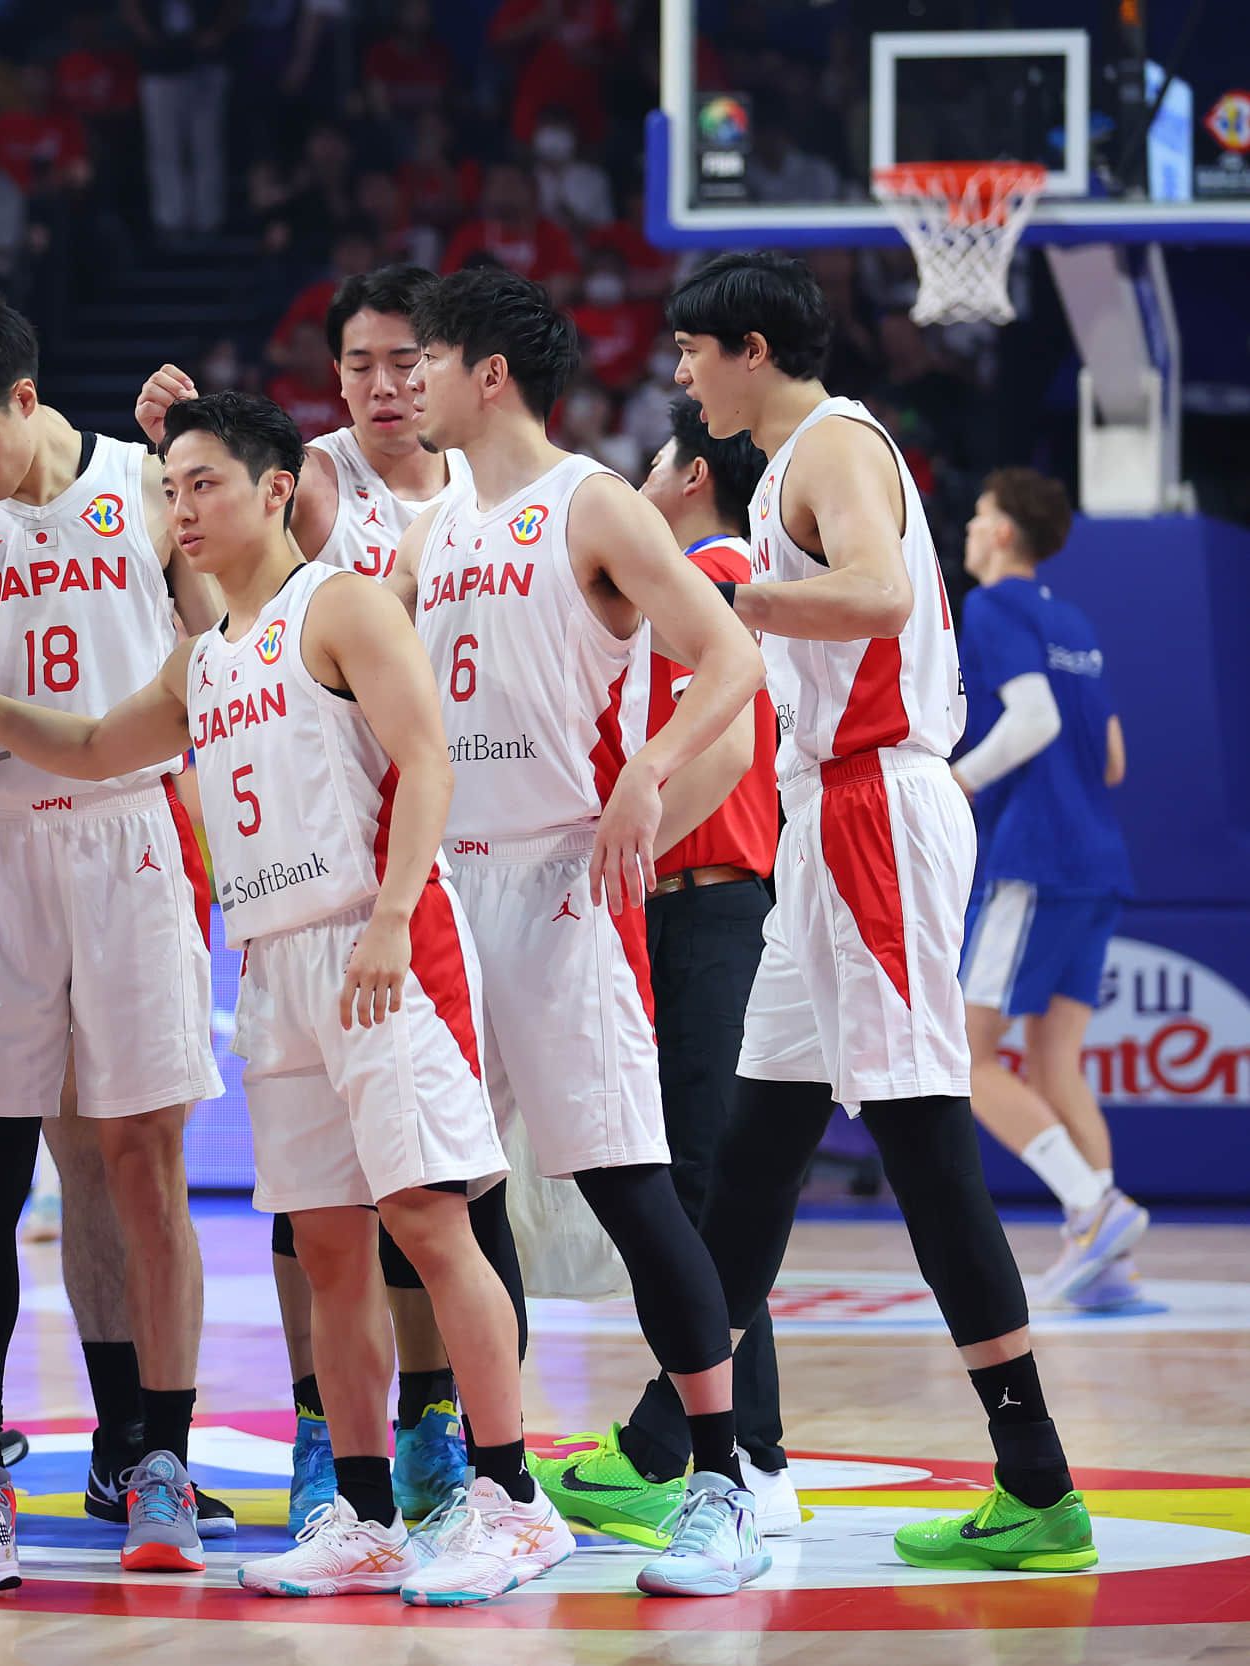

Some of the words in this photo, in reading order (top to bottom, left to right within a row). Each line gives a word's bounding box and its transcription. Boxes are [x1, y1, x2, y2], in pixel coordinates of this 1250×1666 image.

[423, 562, 534, 612] JAPAN
[24, 624, 80, 697] 18
[449, 633, 479, 703] 6
[193, 682, 287, 750] JAPAN
[447, 733, 539, 763] oftBank
[31, 796, 72, 811] JPN
[232, 764, 262, 838] 5
[453, 839, 489, 857] JPN
[234, 852, 330, 904] SoftBank
